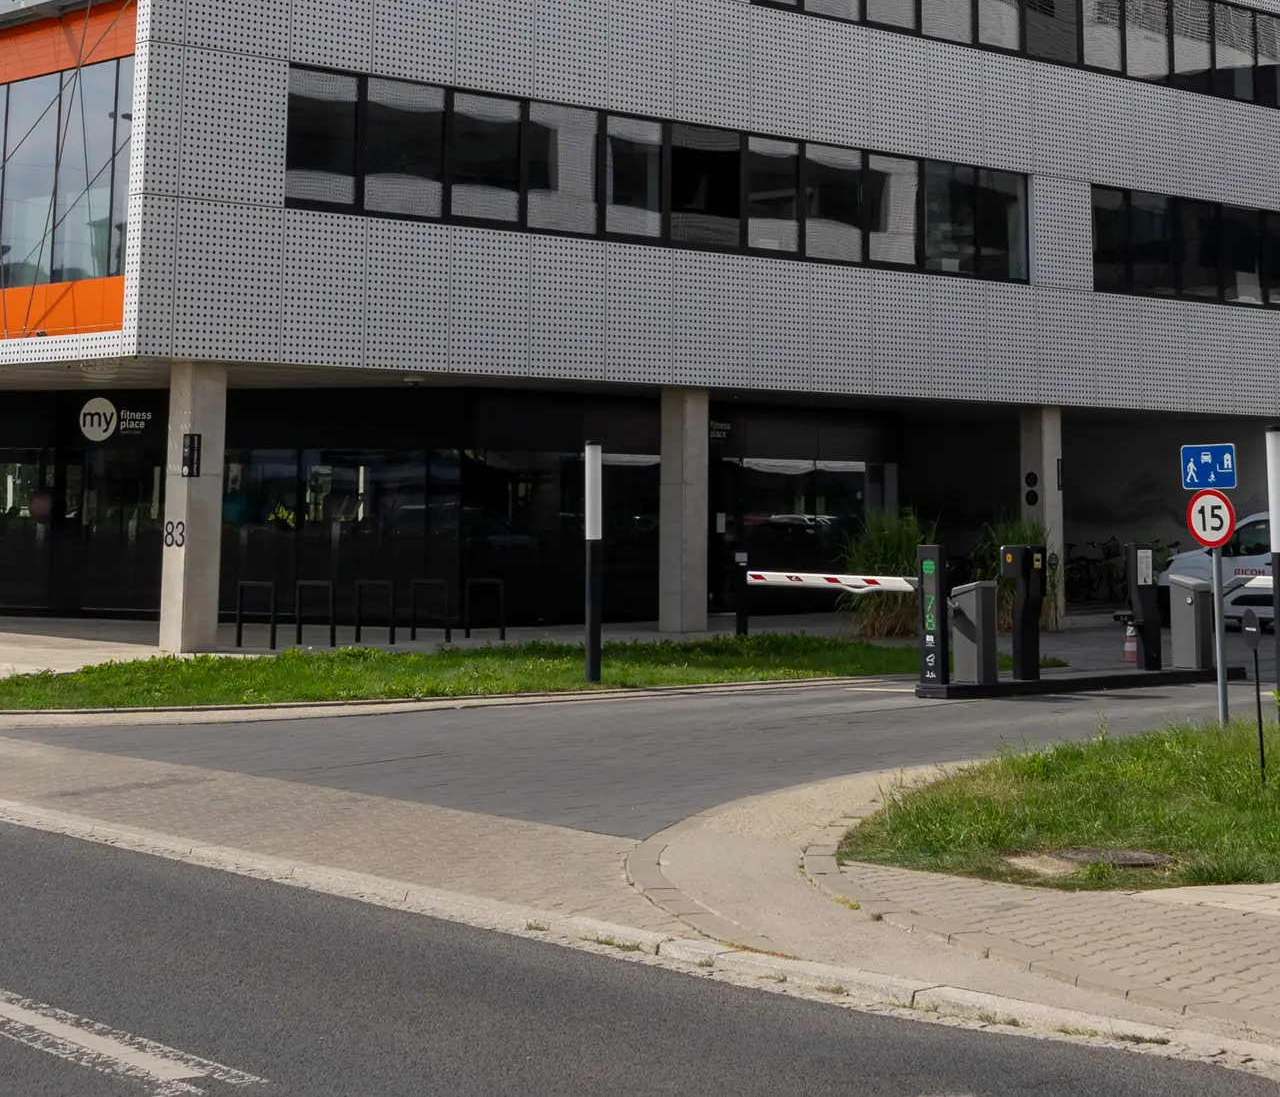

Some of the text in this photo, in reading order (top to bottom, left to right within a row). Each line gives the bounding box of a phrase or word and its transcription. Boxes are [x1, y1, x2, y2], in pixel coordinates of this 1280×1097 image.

[82, 411, 115, 434] my
[120, 409, 152, 420] fitness
[120, 419, 145, 431] place
[1197, 505, 1224, 532] 15
[164, 521, 185, 548] 83
[1234, 568, 1266, 576] RICOH
